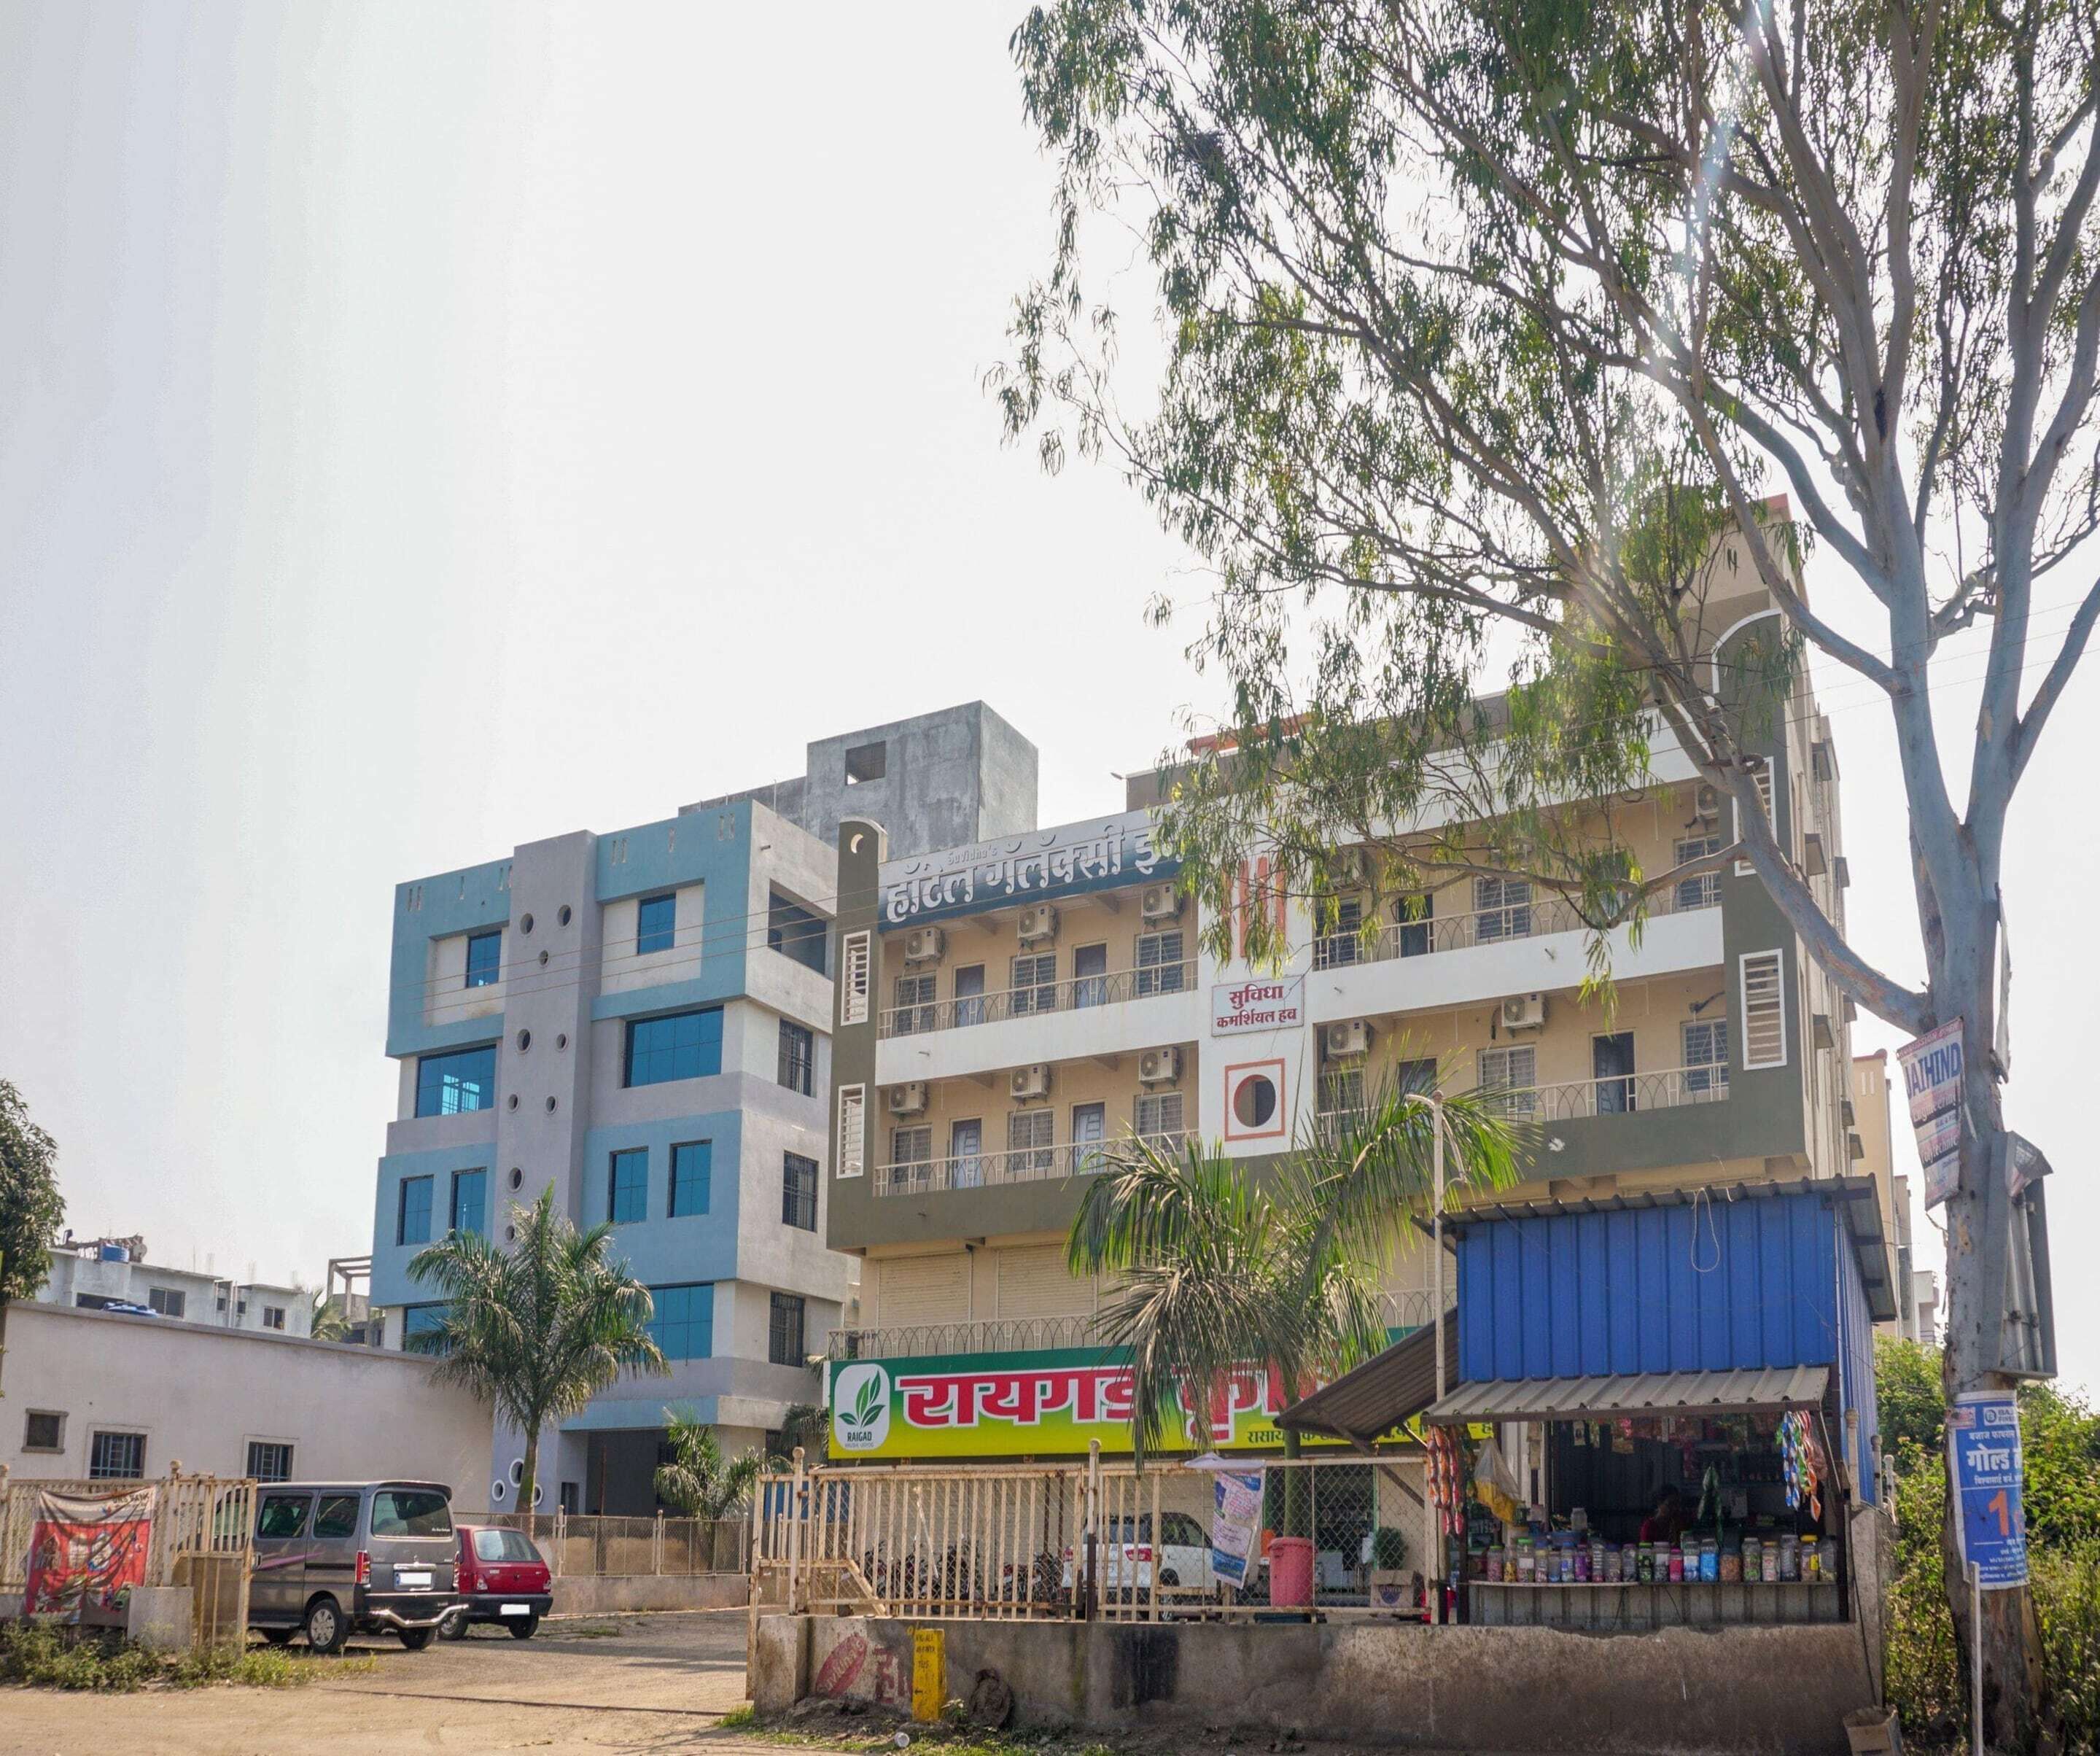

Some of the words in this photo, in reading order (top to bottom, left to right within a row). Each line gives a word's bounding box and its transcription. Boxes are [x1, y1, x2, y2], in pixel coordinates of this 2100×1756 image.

[886, 862, 977, 923] हॉटेल
[1229, 984, 1284, 1009] सुविधा
[1216, 1009, 1275, 1027] कमर्शियल
[847, 1431, 872, 1442] RAIGAD
[1966, 1442, 2010, 1472] गोल्ड
